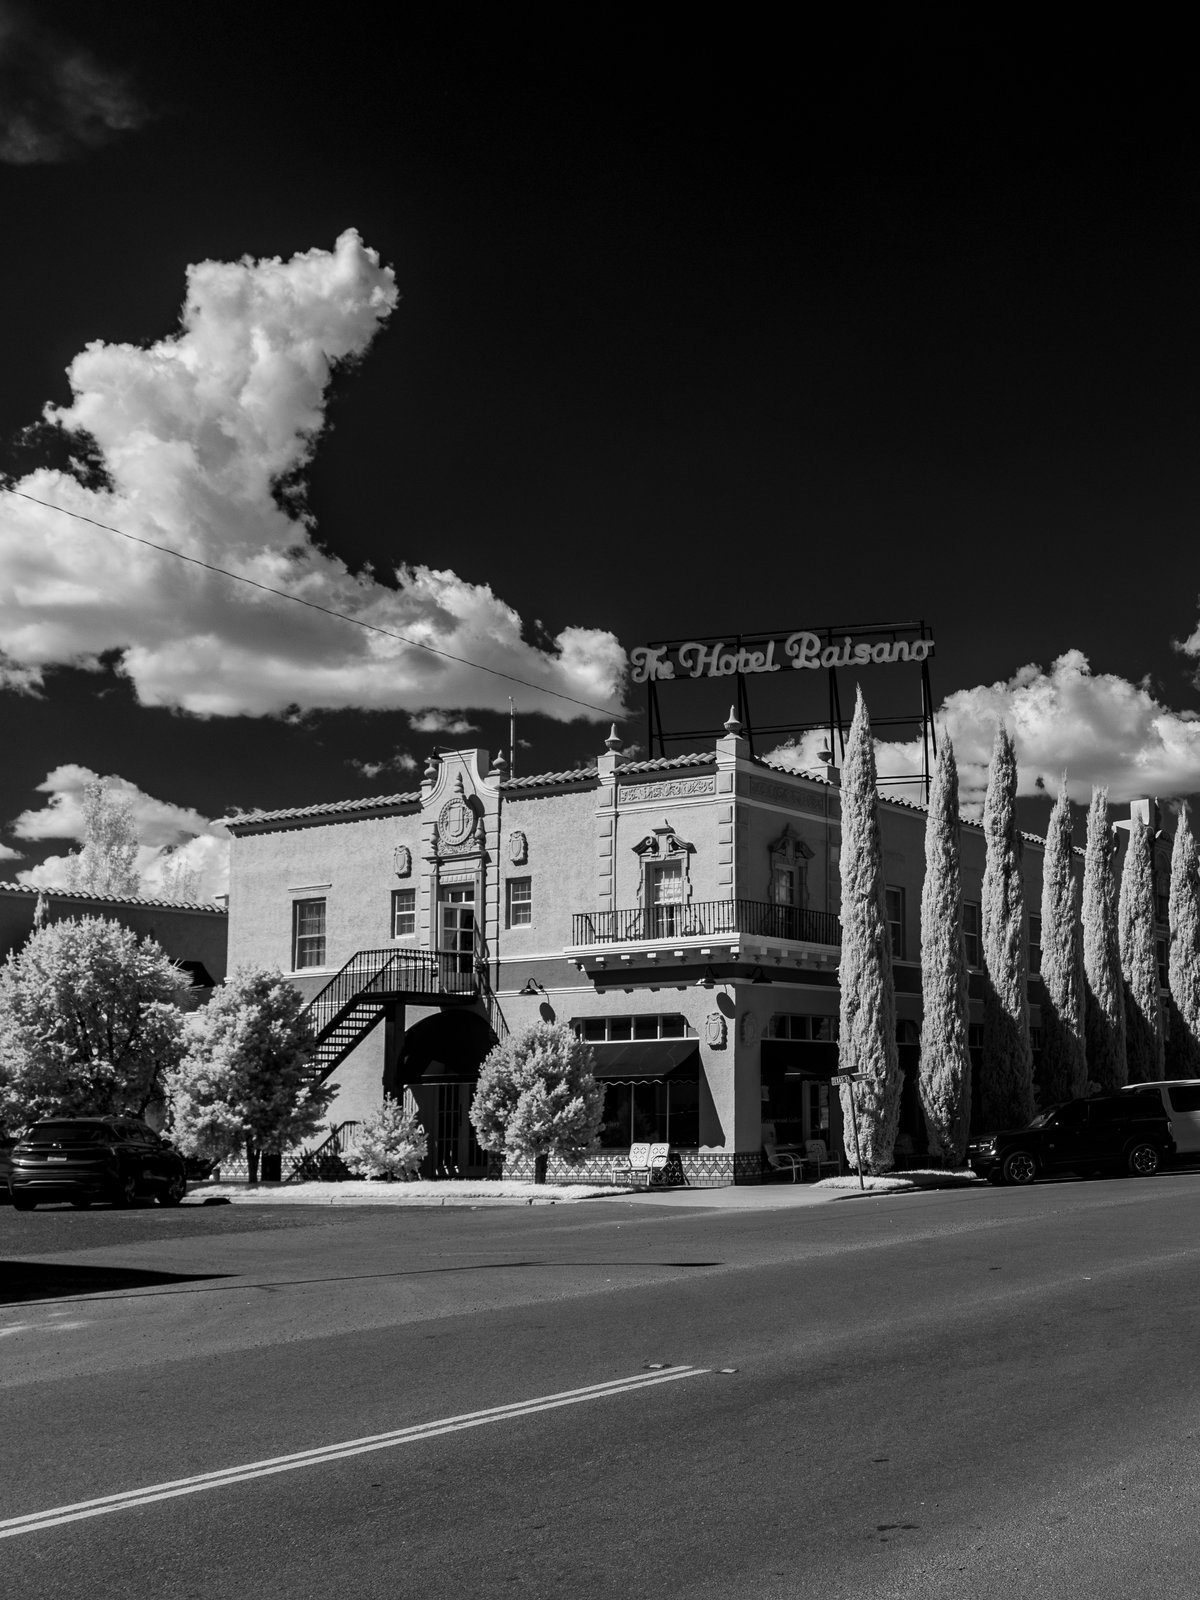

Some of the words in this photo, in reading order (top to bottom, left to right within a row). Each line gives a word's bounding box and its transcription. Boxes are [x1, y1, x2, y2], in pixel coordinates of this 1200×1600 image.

[632, 646, 675, 683] The
[679, 640, 781, 678] Hotel
[785, 632, 935, 669] Paisano
